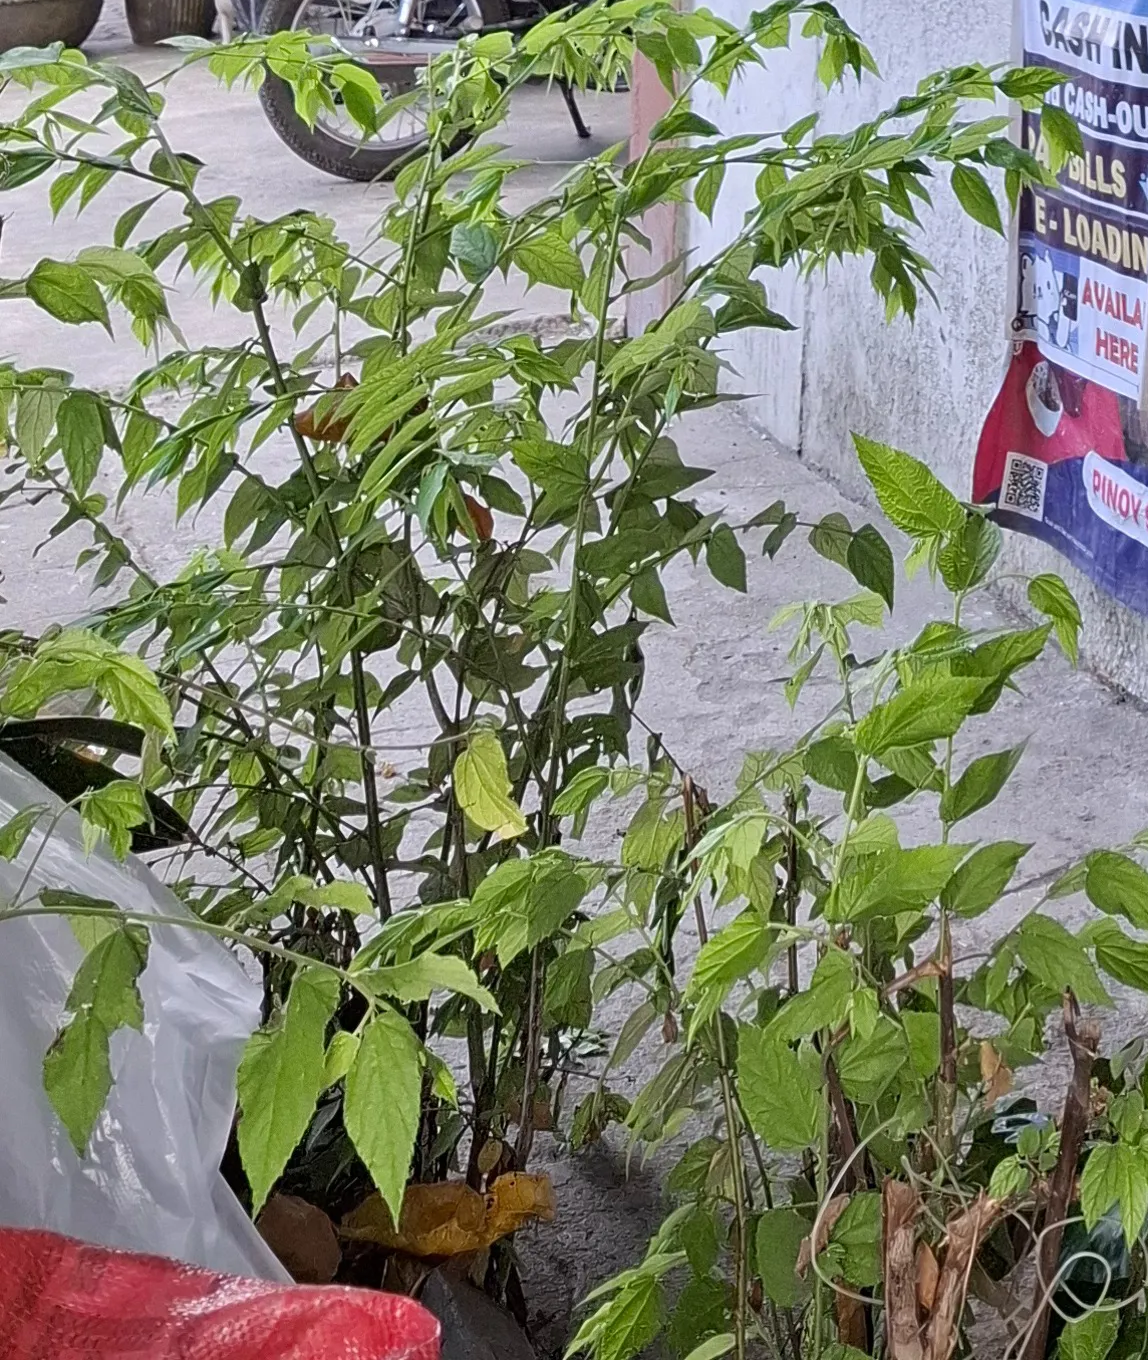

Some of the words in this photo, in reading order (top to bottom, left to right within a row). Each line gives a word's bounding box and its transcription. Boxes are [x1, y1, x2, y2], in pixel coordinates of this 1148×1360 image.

[1039, 0, 1111, 65] CASH
[1082, 277, 1146, 330] AVAILA
[1095, 327, 1139, 375] HERE
[1092, 468, 1142, 526] PINOY
